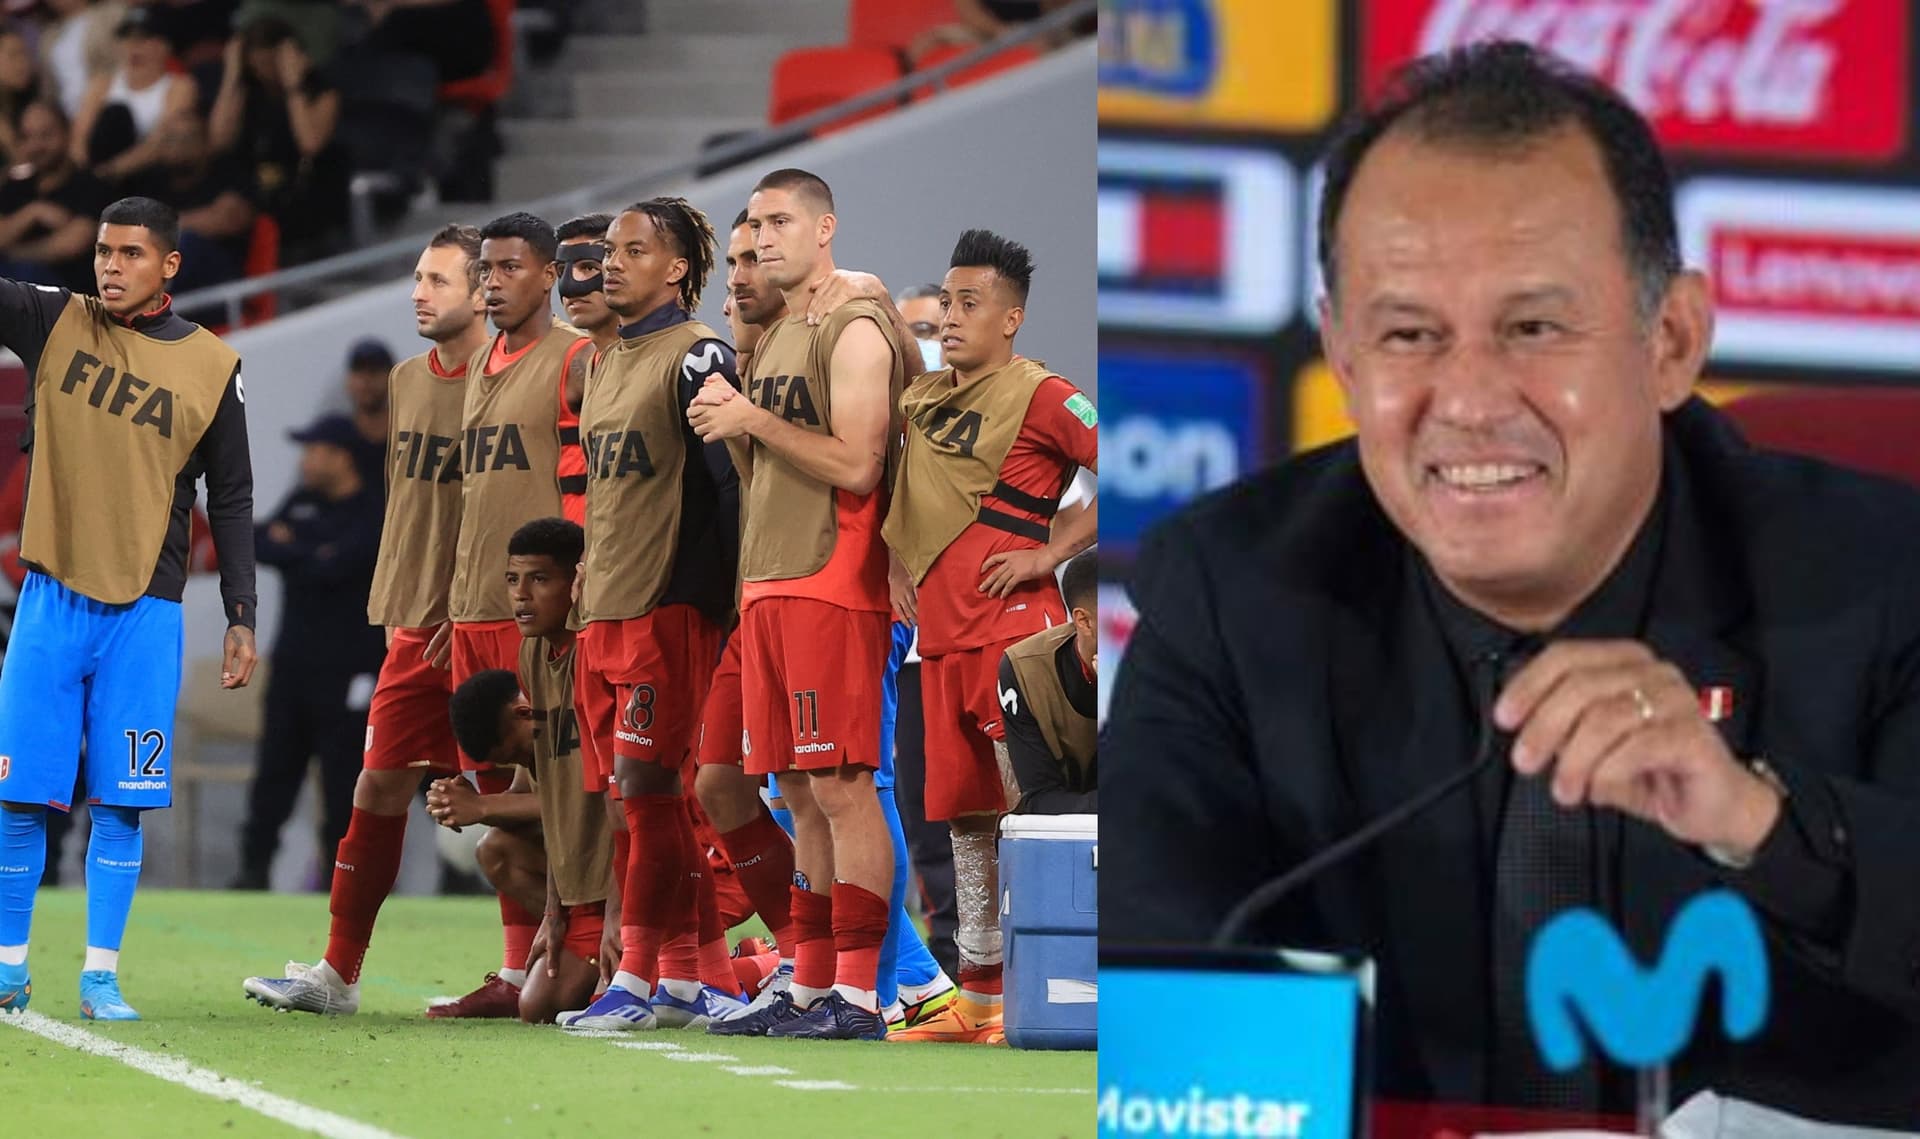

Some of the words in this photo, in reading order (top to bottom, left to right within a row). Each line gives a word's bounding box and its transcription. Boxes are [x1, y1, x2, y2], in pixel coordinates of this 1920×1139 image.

[60, 350, 173, 439] FIFA
[461, 424, 531, 471] IFA
[793, 690, 819, 739] 11
[125, 729, 166, 777] 12
[118, 781, 167, 790] marathon
